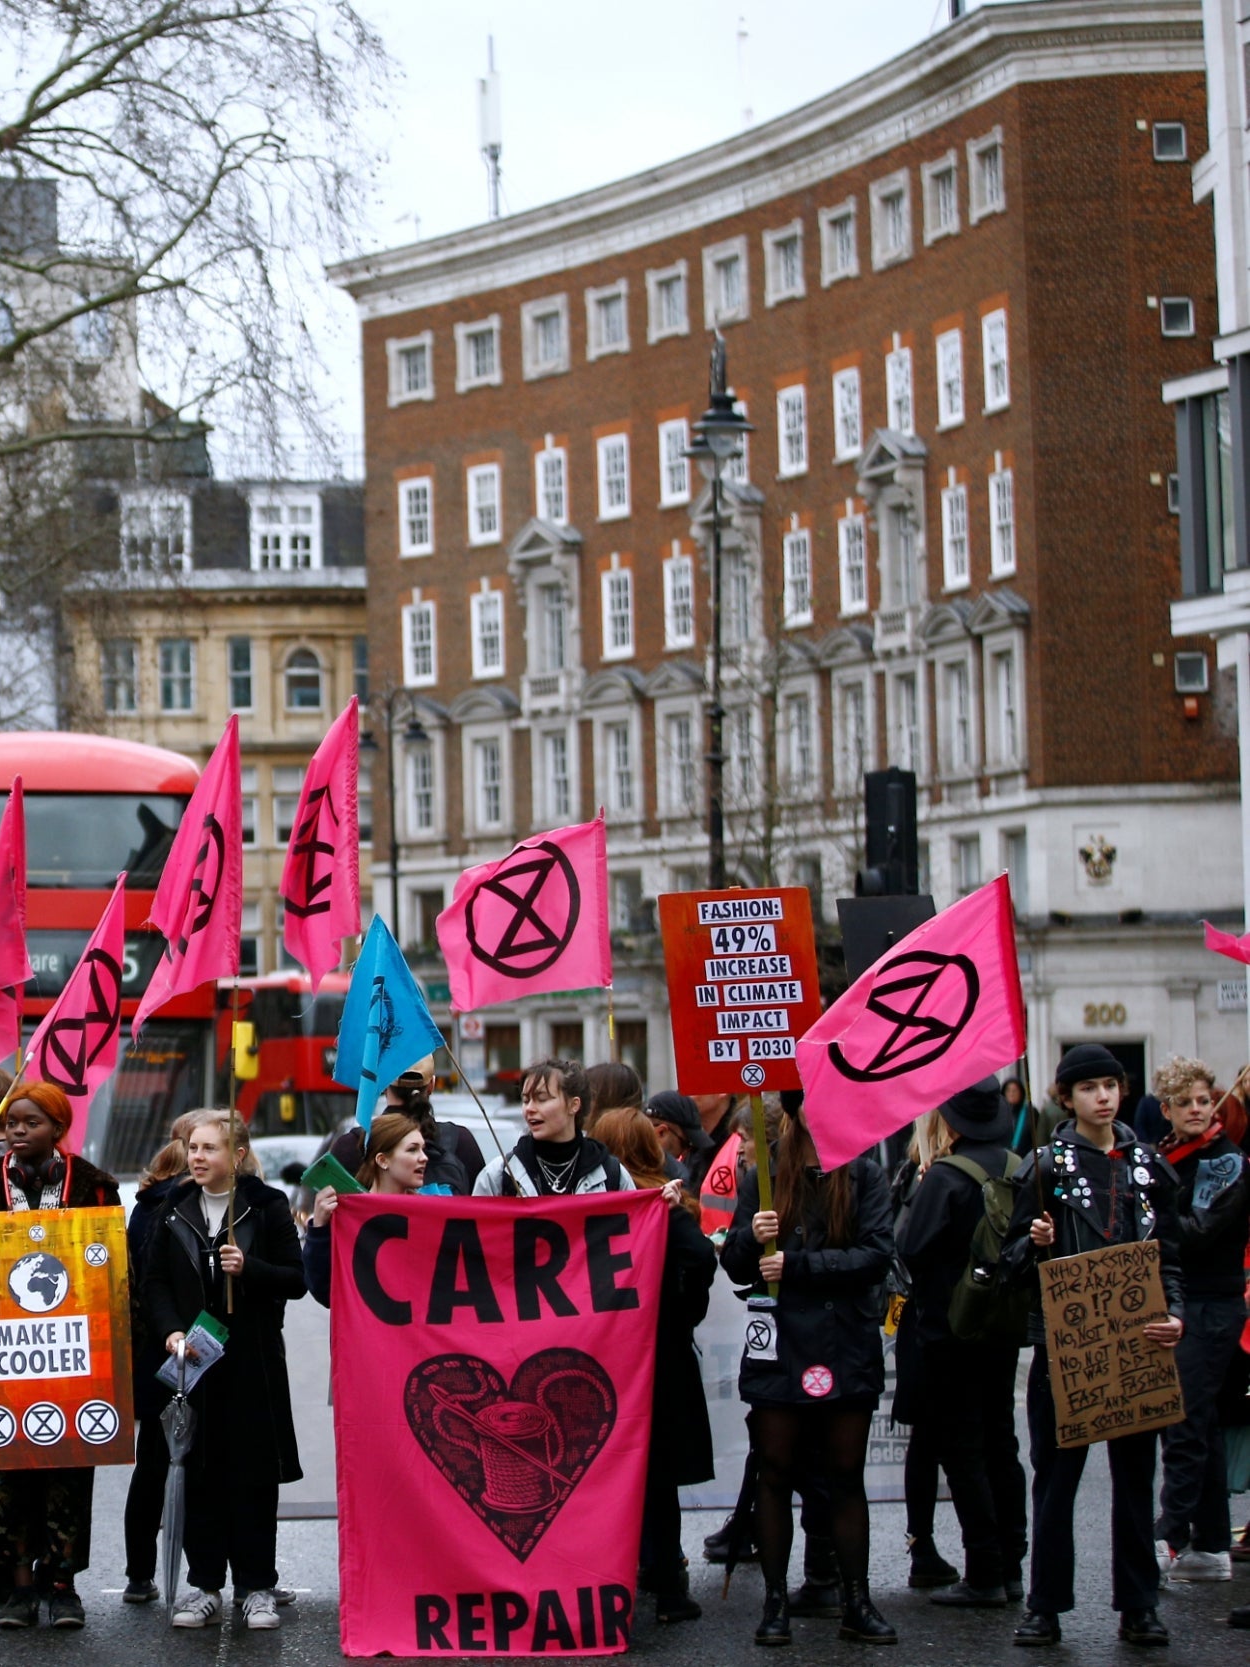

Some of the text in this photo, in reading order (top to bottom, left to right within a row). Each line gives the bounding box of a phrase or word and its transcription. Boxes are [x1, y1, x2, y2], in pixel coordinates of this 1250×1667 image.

[700, 900, 780, 919] FASHION:
[715, 925, 771, 952] 49%
[710, 957, 788, 977] INCREASE
[698, 982, 797, 1003] IN CLIMATE
[721, 1011, 783, 1029] IMPACT
[1083, 1002, 1126, 1027] 200
[713, 1039, 792, 1057] BY 2030
[352, 1213, 640, 1326] CARE
[1046, 1244, 1160, 1282] WHO DESTROYED
[1048, 1278, 1082, 1302] THE
[1122, 1267, 1152, 1289] SEA
[1091, 1289, 1113, 1317] !?
[65, 1321, 83, 1343] IT
[1077, 1323, 1105, 1345] NOT
[1085, 1344, 1112, 1366] NOT
[1062, 1371, 1080, 1392] IT
[1083, 1362, 1110, 1383] WAS
[1067, 1365, 1176, 1412] FAST FASHION
[1058, 1421, 1089, 1439] THE
[414, 1583, 633, 1653] REPAIR
